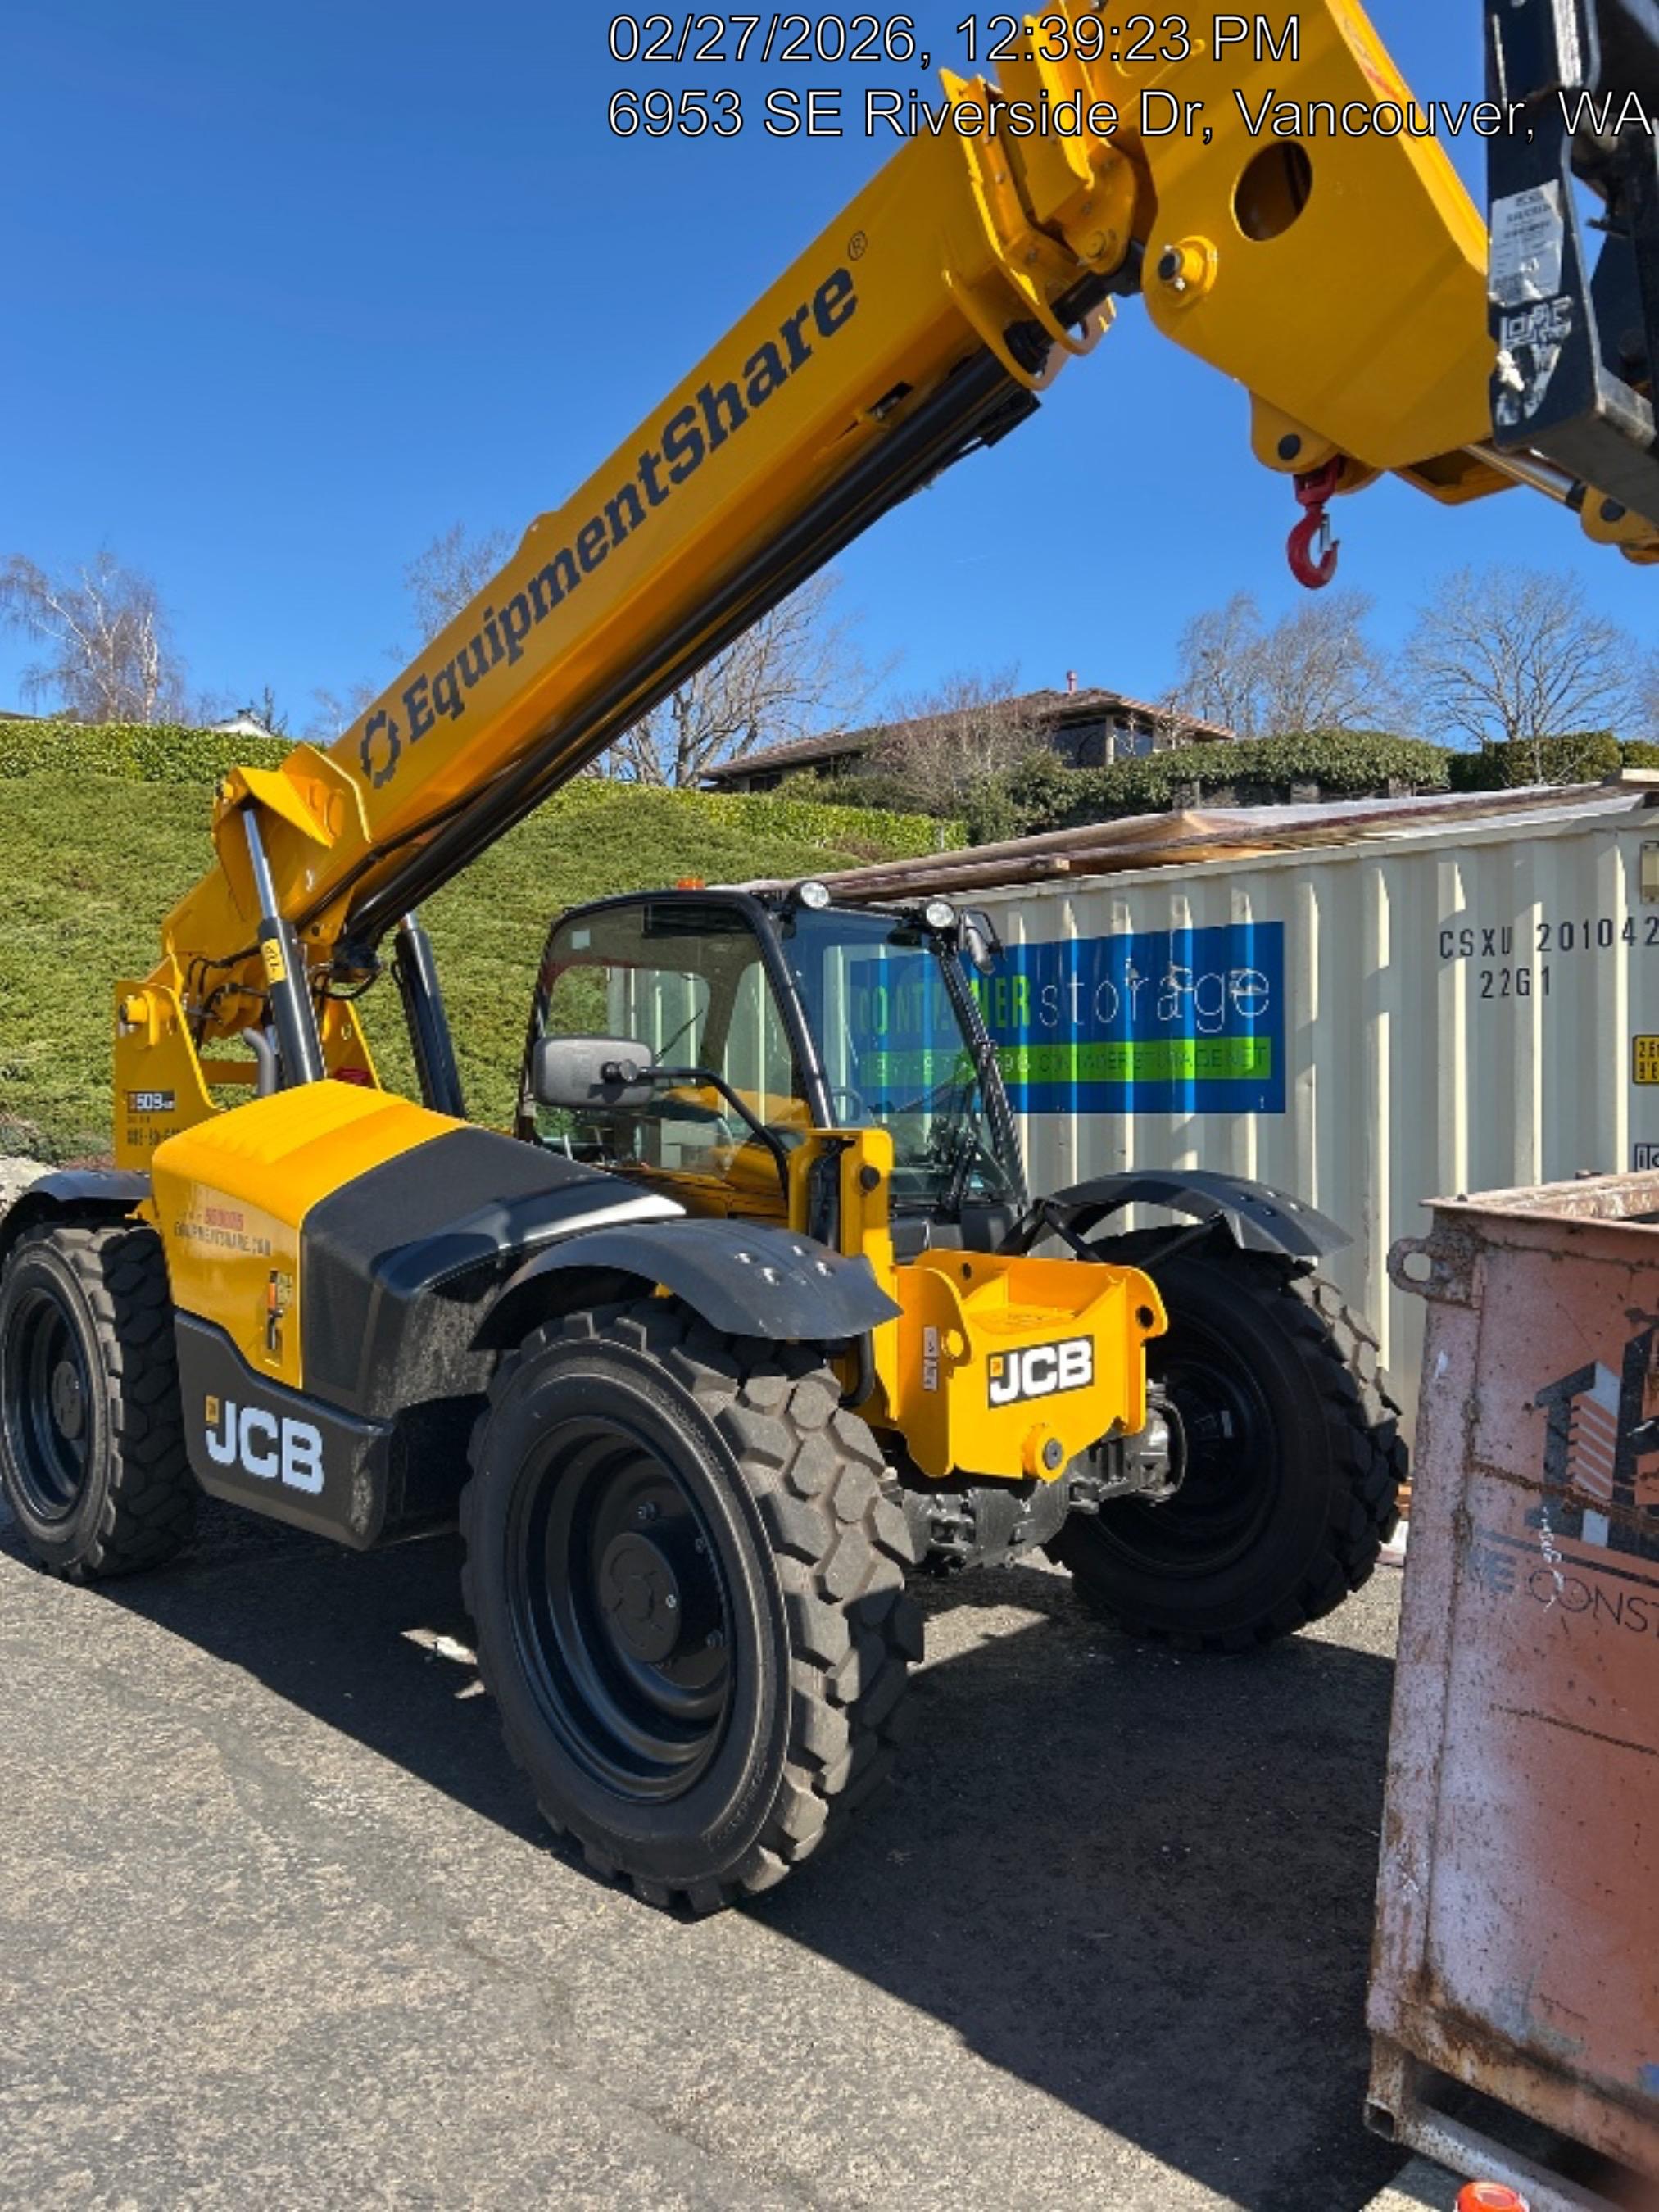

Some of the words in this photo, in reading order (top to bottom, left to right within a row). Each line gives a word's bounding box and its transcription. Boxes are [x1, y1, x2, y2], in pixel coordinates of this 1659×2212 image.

[1439, 925, 1513, 959] CSXU
[1039, 968, 1270, 1033] storage
[1480, 966, 1551, 999] 22G1
[990, 1339, 1093, 1403] JCB
[206, 1399, 325, 1494] JCB
